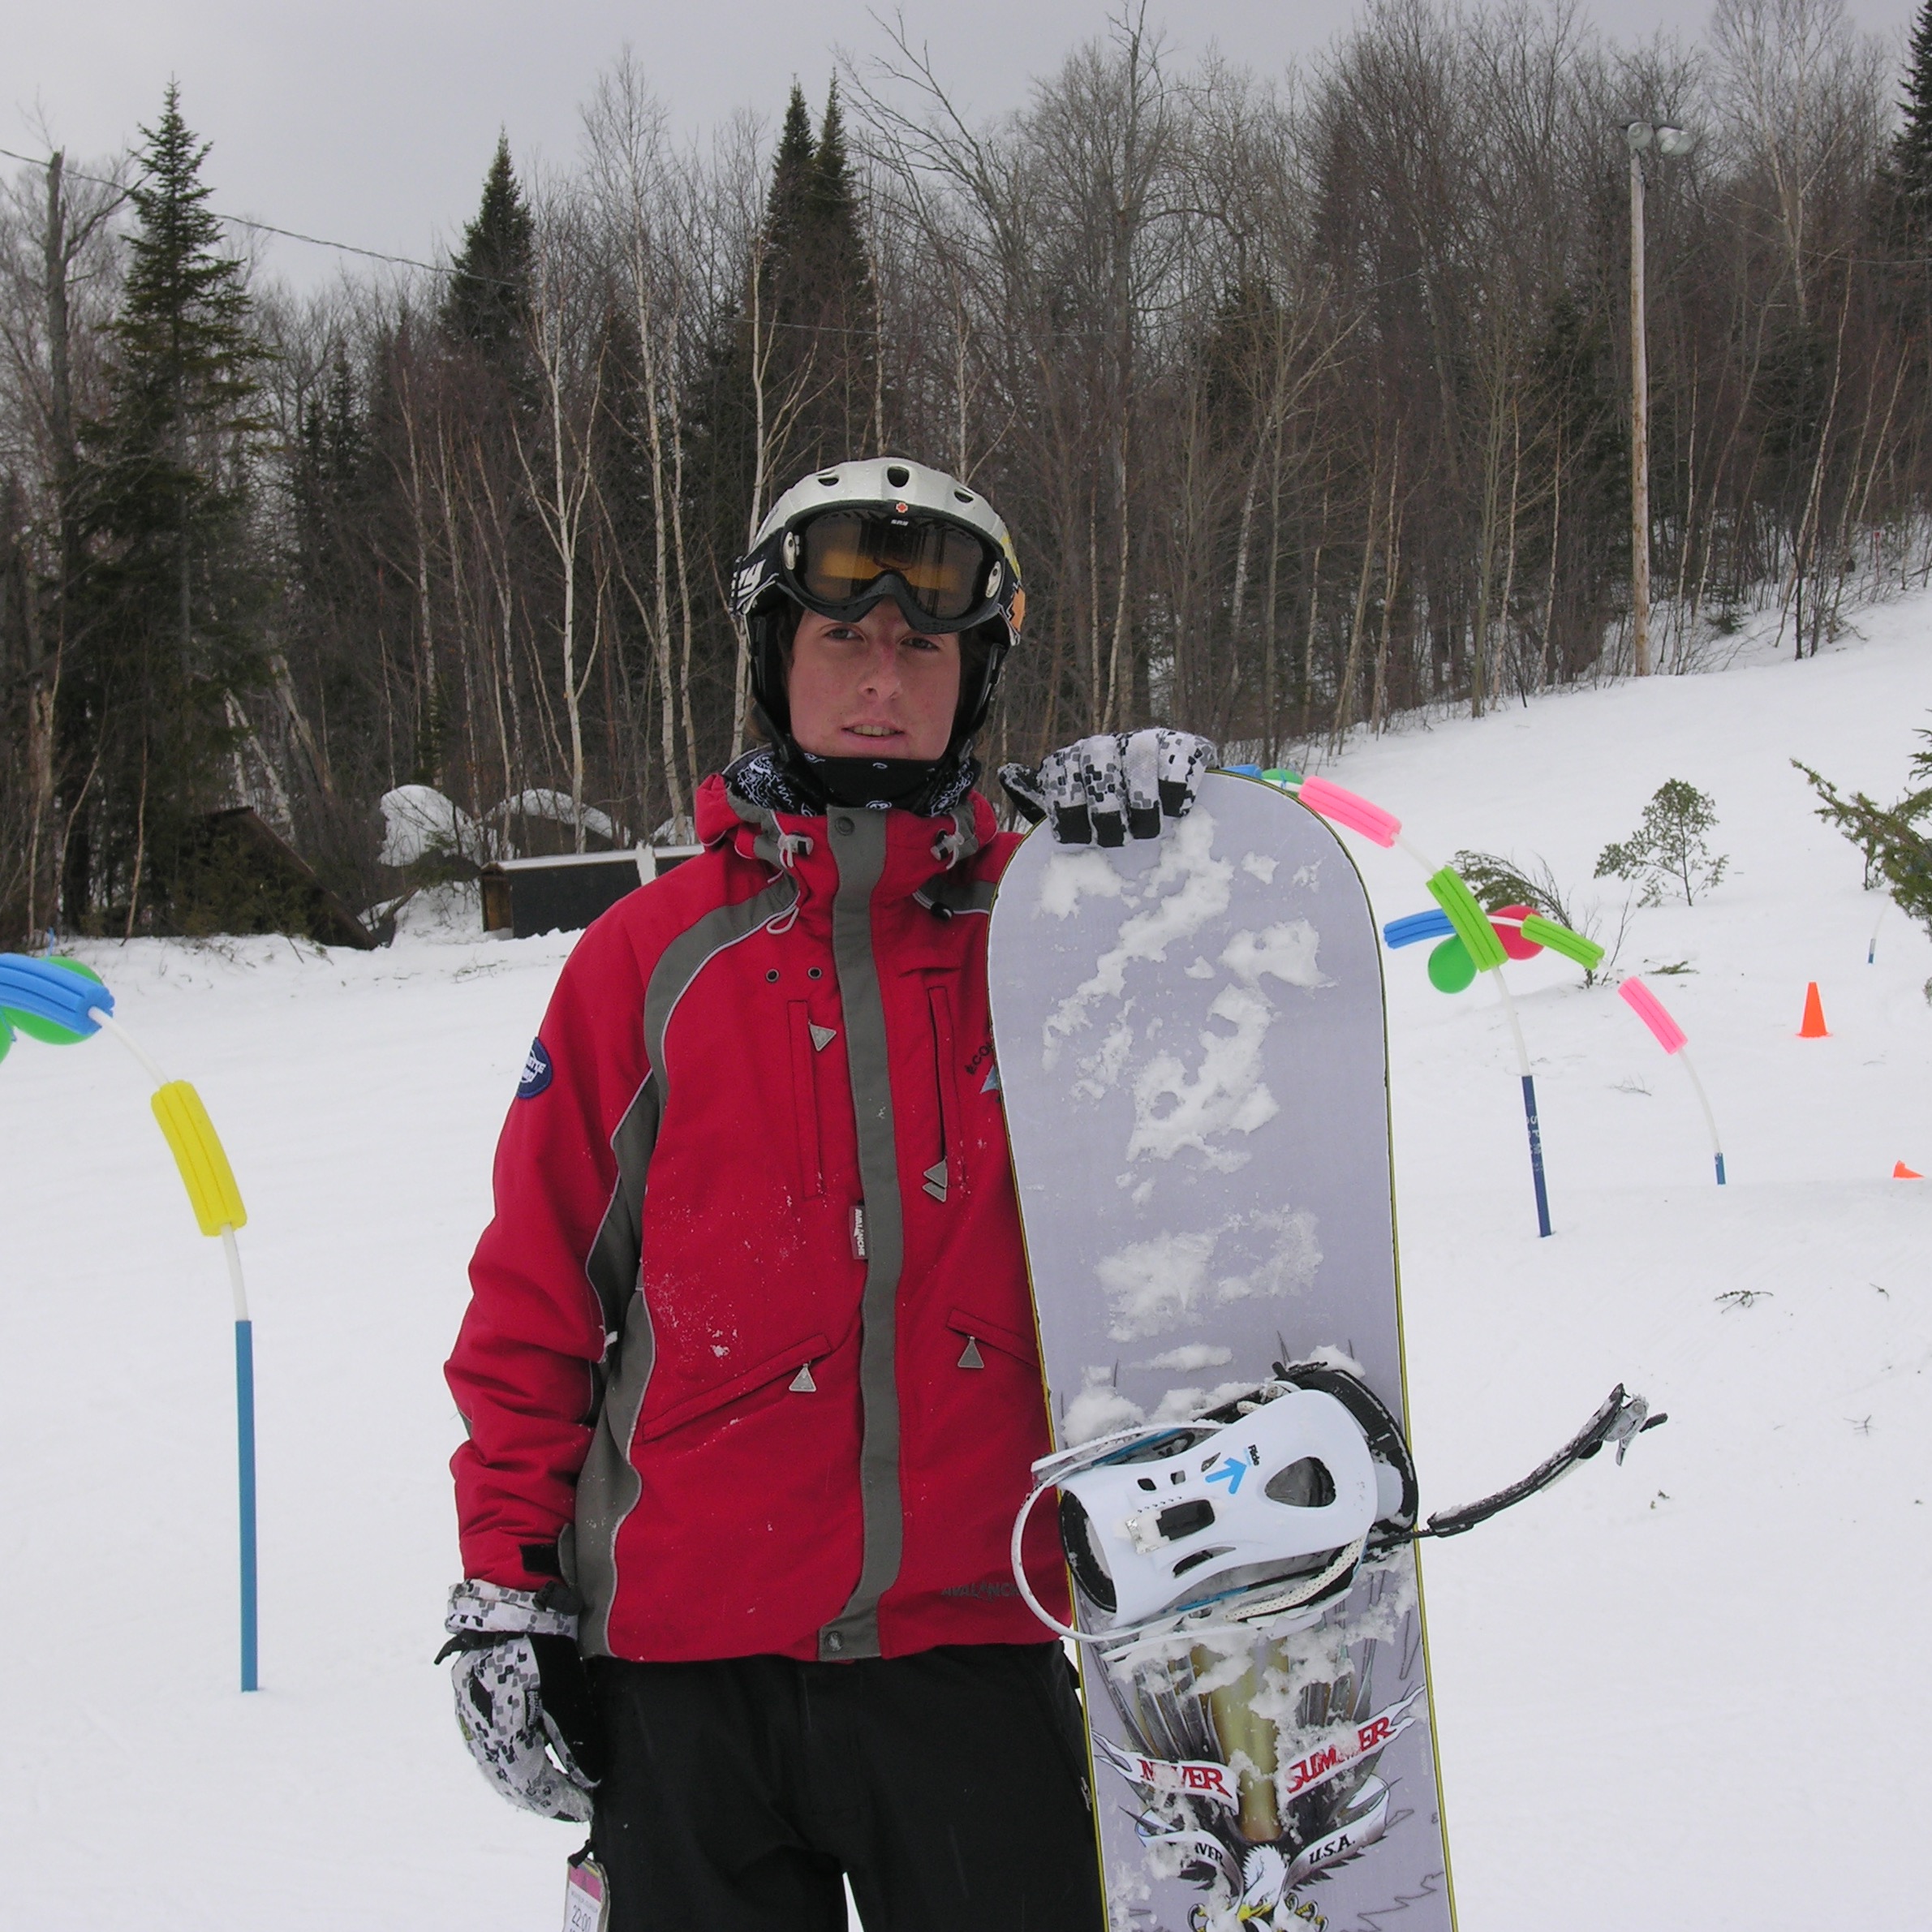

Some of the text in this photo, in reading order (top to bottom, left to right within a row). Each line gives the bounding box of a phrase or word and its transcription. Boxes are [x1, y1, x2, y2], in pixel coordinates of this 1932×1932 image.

[1248, 1444, 1260, 1466] Ride
[1137, 1758, 1233, 1799] NVER
[1287, 1716, 1396, 1794] SUMER
[1309, 1833, 1356, 1865] U.S.A.
